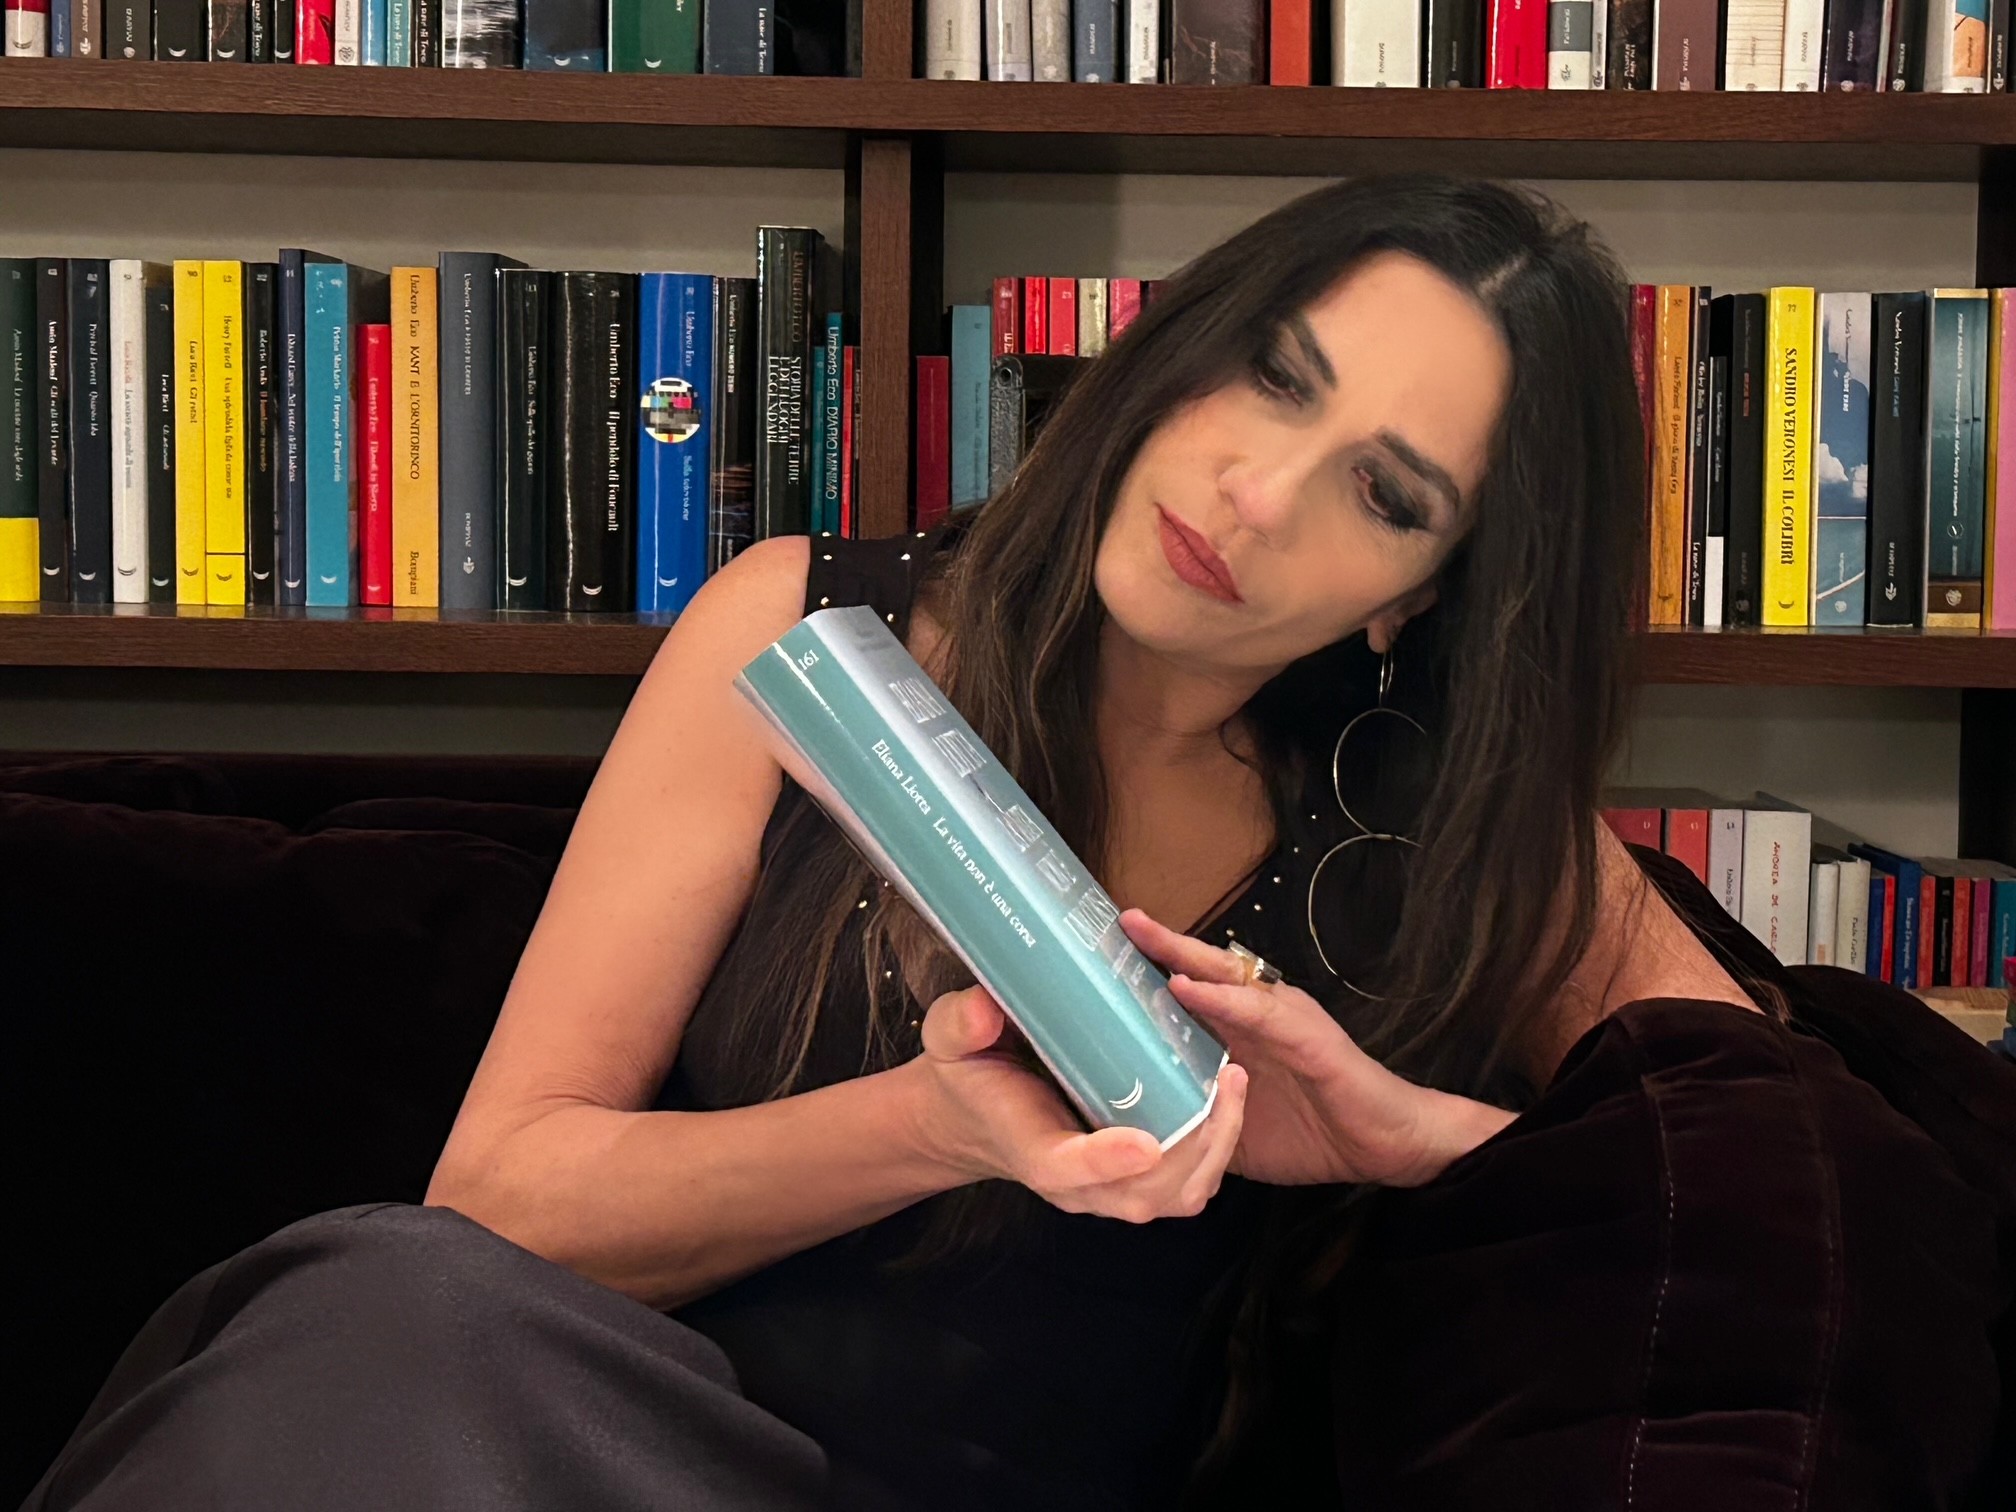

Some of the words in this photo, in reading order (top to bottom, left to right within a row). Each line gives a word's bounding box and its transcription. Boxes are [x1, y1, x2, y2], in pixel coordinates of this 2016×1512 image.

[410, 274, 421, 314] Umberto
[410, 319, 420, 337] Eco
[608, 323, 621, 375] Umberto
[410, 345, 421, 376] KANT
[827, 326, 839, 375] Umberto
[410, 380, 420, 389] E
[608, 376, 621, 399] Eco
[789, 356, 802, 399] STORIA
[827, 378, 839, 400] Eco
[1784, 347, 1797, 407] SANDRO
[608, 410, 621, 419] Il
[767, 356, 779, 444] LEGGENDARI
[789, 401, 802, 441] DELLE
[409, 393, 421, 480] L'ORNITORINCO
[606, 421, 621, 468] pendolo
[826, 406, 839, 450] DIARIO
[1782, 409, 1797, 482] VERONESI
[608, 469, 620, 480] di
[787, 444, 801, 485] TERRE
[825, 452, 838, 500] MINIMO
[607, 483, 620, 532] Foucault
[1782, 489, 1795, 506] IL
[1780, 507, 1795, 566] COLIBRÌ
[408, 550, 420, 595] Bompiani
[798, 649, 820, 671] 161
[871, 738, 904, 780] Eliana
[933, 815, 949, 838] La
[947, 835, 967, 861] vita
[964, 858, 986, 885] non
[984, 881, 995, 894] è
[991, 892, 1012, 918] una
[1009, 916, 1037, 948] corsa
[1771, 841, 1781, 886] ANDREA
